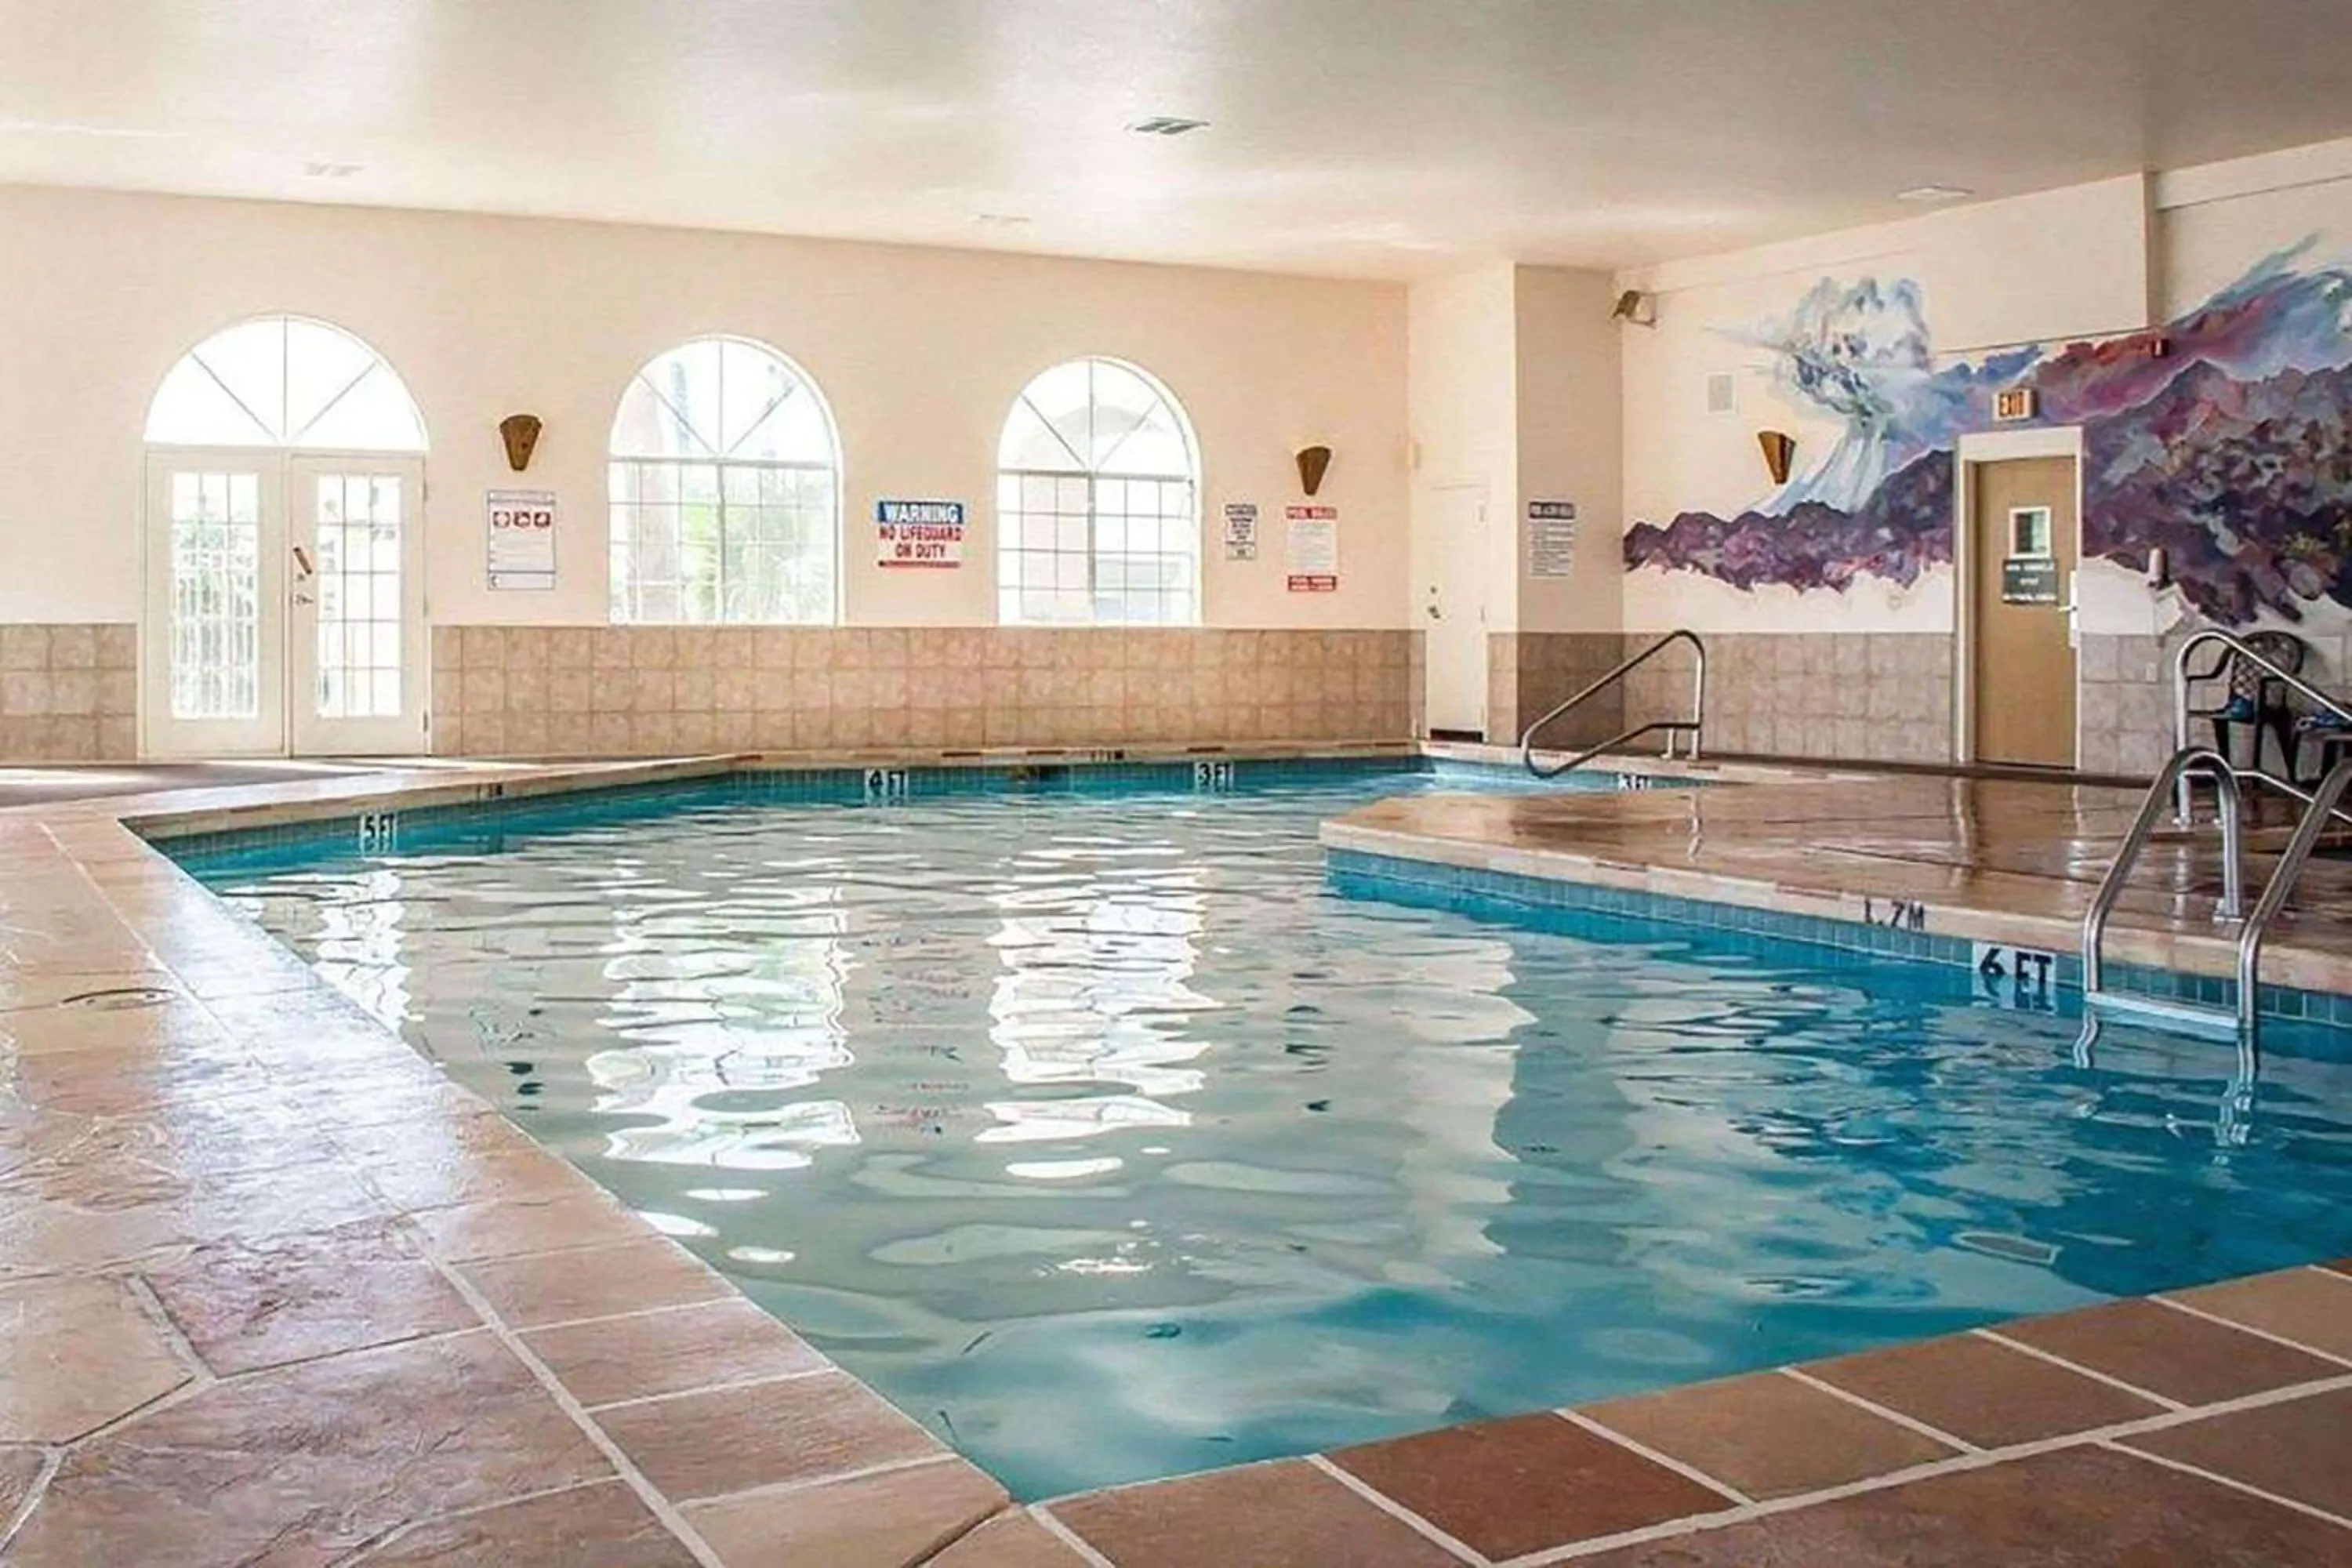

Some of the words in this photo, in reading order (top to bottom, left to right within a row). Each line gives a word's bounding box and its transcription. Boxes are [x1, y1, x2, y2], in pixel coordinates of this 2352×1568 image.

[884, 504, 958, 523] WARNING
[880, 525, 895, 540] NO
[899, 525, 961, 541] LIFEGUARD
[895, 543, 912, 557] ON
[916, 543, 946, 558] DUTY
